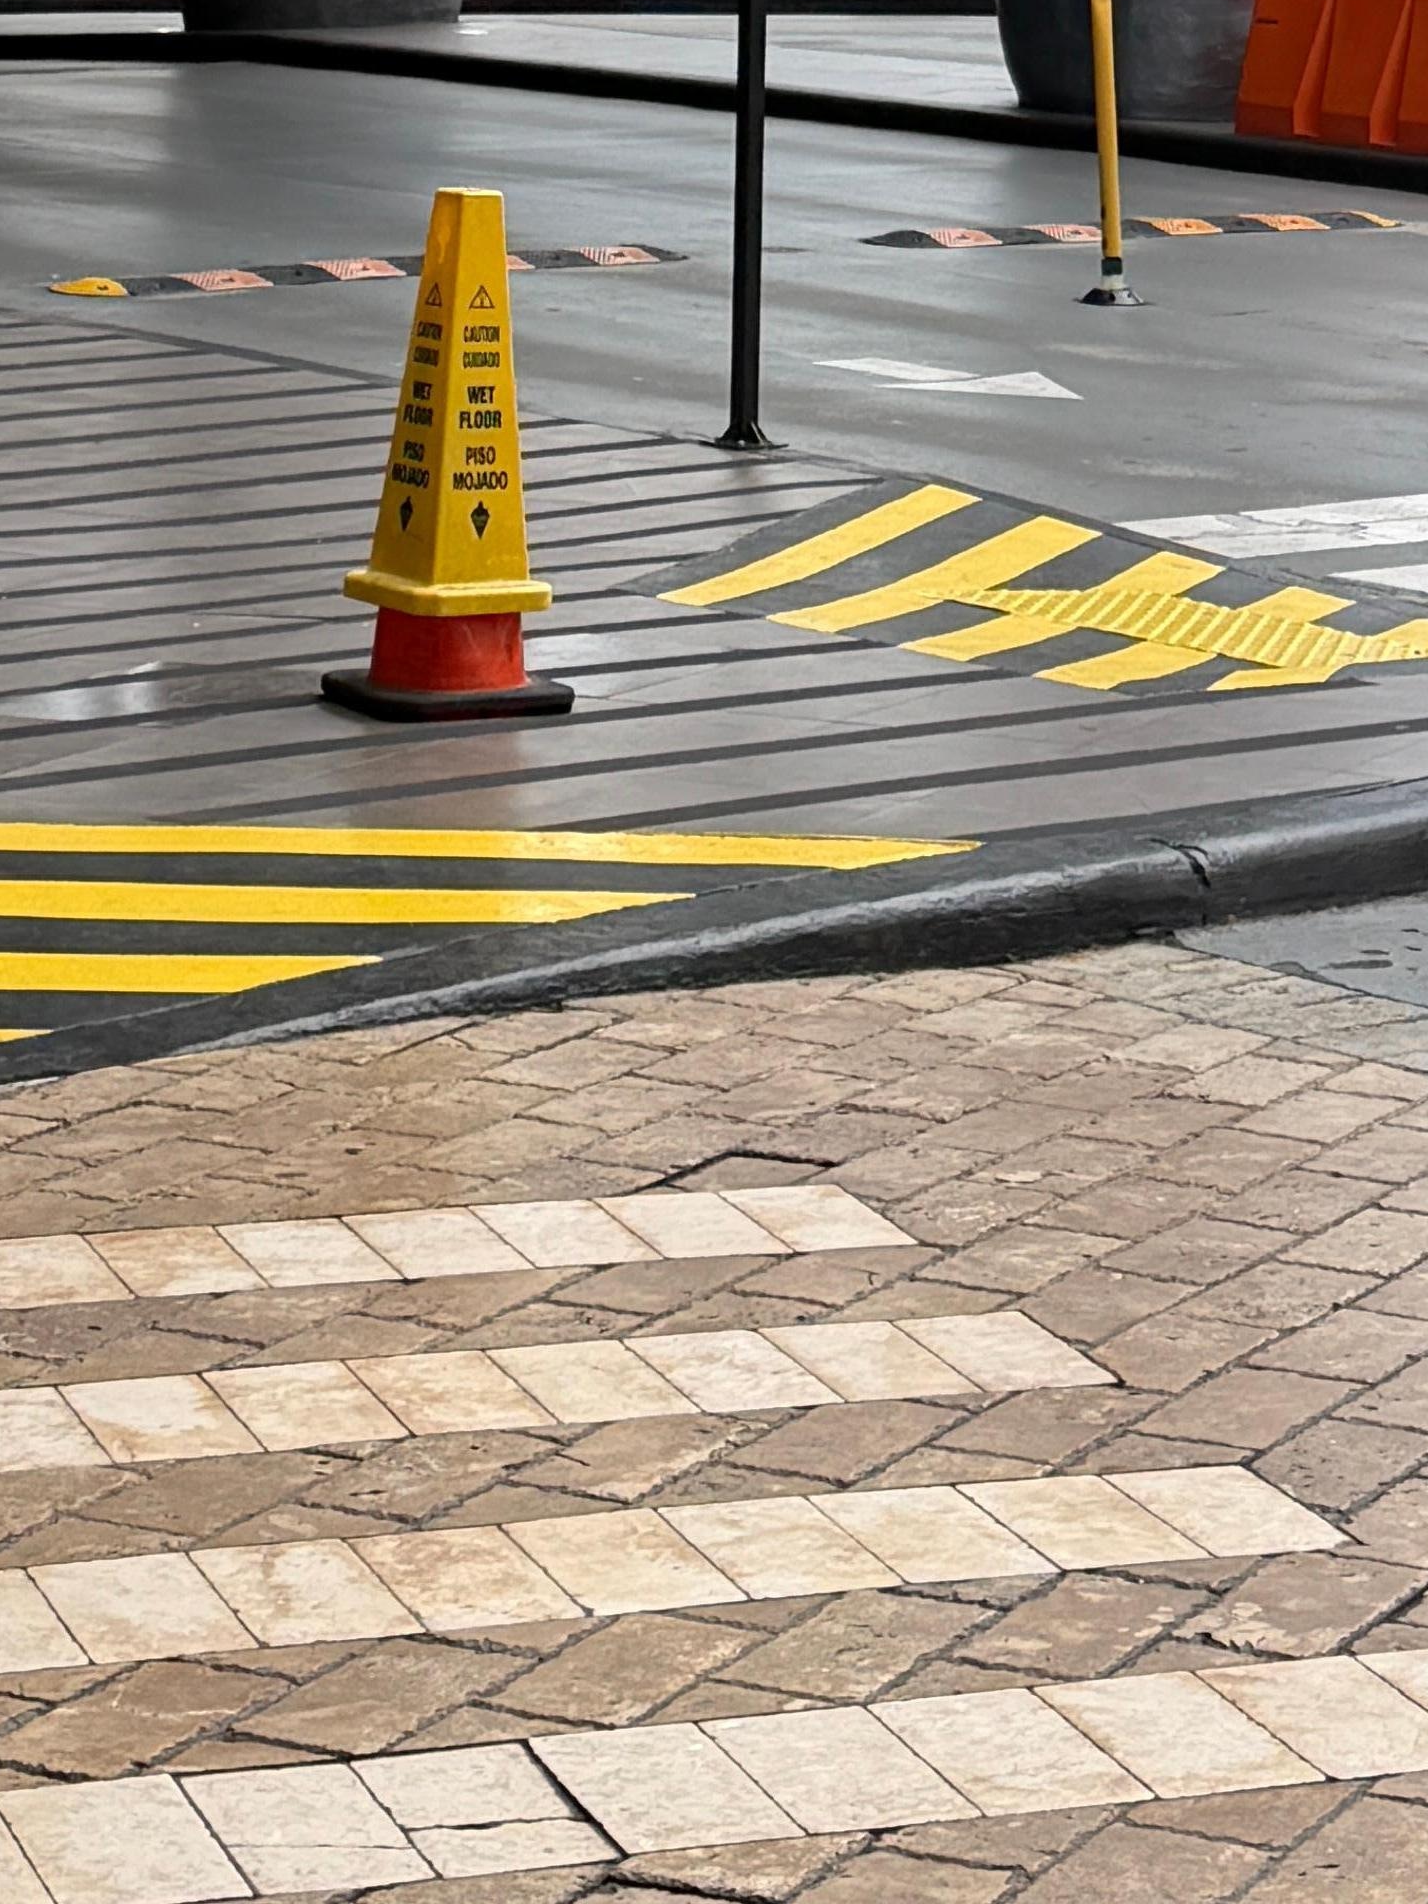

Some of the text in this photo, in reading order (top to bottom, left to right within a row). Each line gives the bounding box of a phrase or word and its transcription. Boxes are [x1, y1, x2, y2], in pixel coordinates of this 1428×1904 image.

[467, 386, 495, 404] WET
[459, 410, 502, 429] FLOOR
[466, 446, 496, 466] PISO
[453, 471, 508, 490] MOJADO
